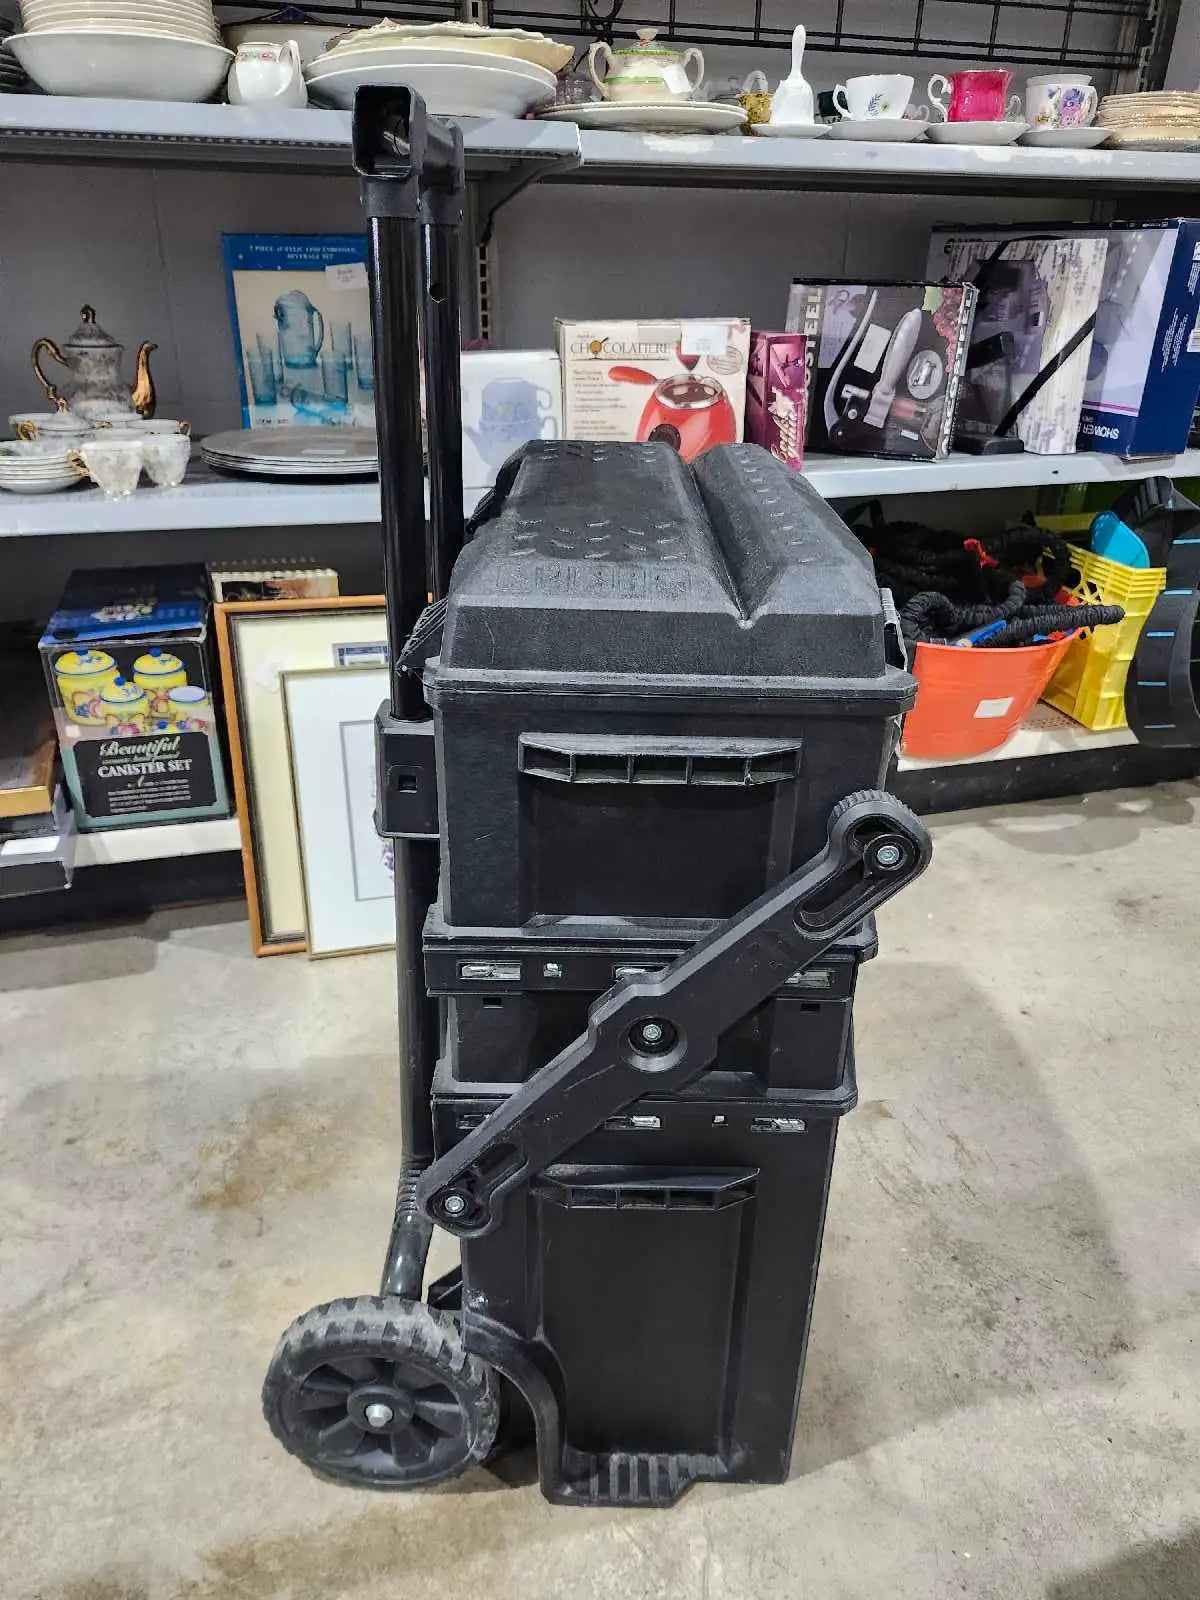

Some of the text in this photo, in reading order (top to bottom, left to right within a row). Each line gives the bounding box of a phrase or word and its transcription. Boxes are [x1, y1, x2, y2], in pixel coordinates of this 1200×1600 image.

[100, 735, 181, 757] Beautiful
[97, 759, 193, 778] CANISTER SET
